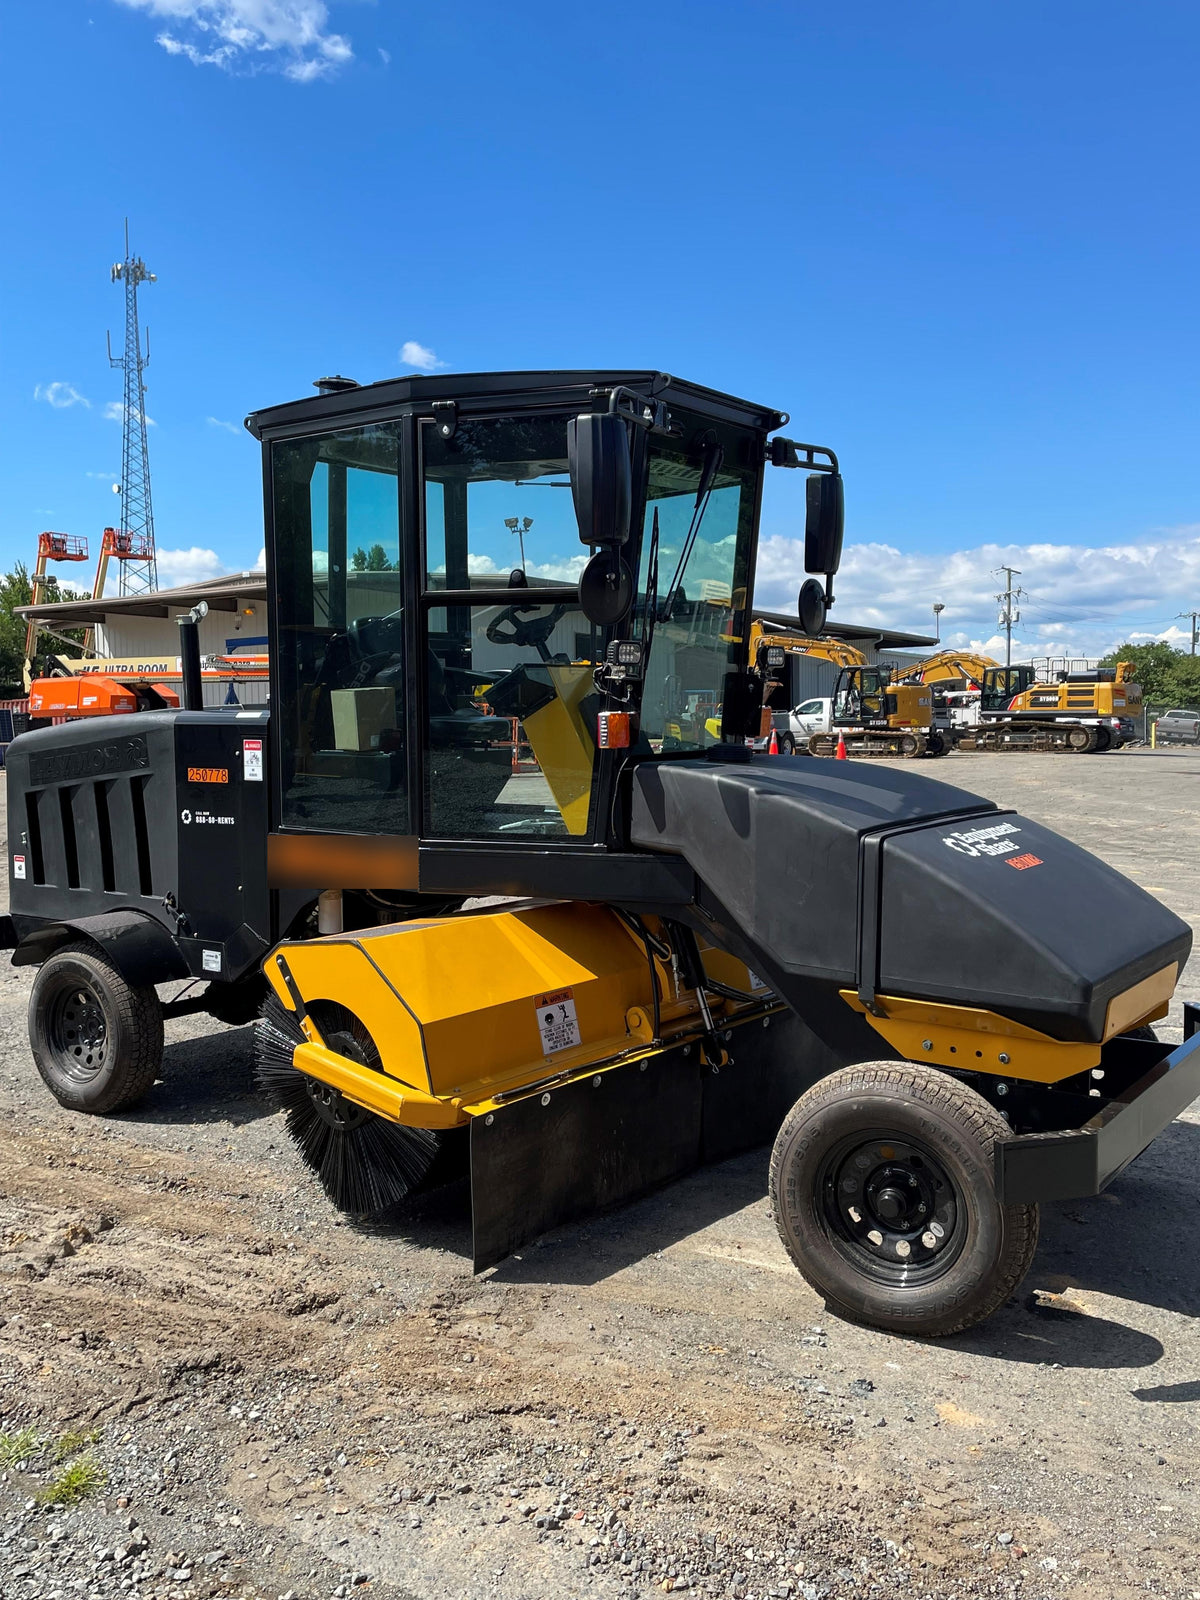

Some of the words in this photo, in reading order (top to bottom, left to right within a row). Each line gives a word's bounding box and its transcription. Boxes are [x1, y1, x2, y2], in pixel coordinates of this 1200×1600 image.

[188, 768, 228, 782] 250778
[950, 822, 1022, 843] Equipment
[975, 838, 1020, 856] Share
